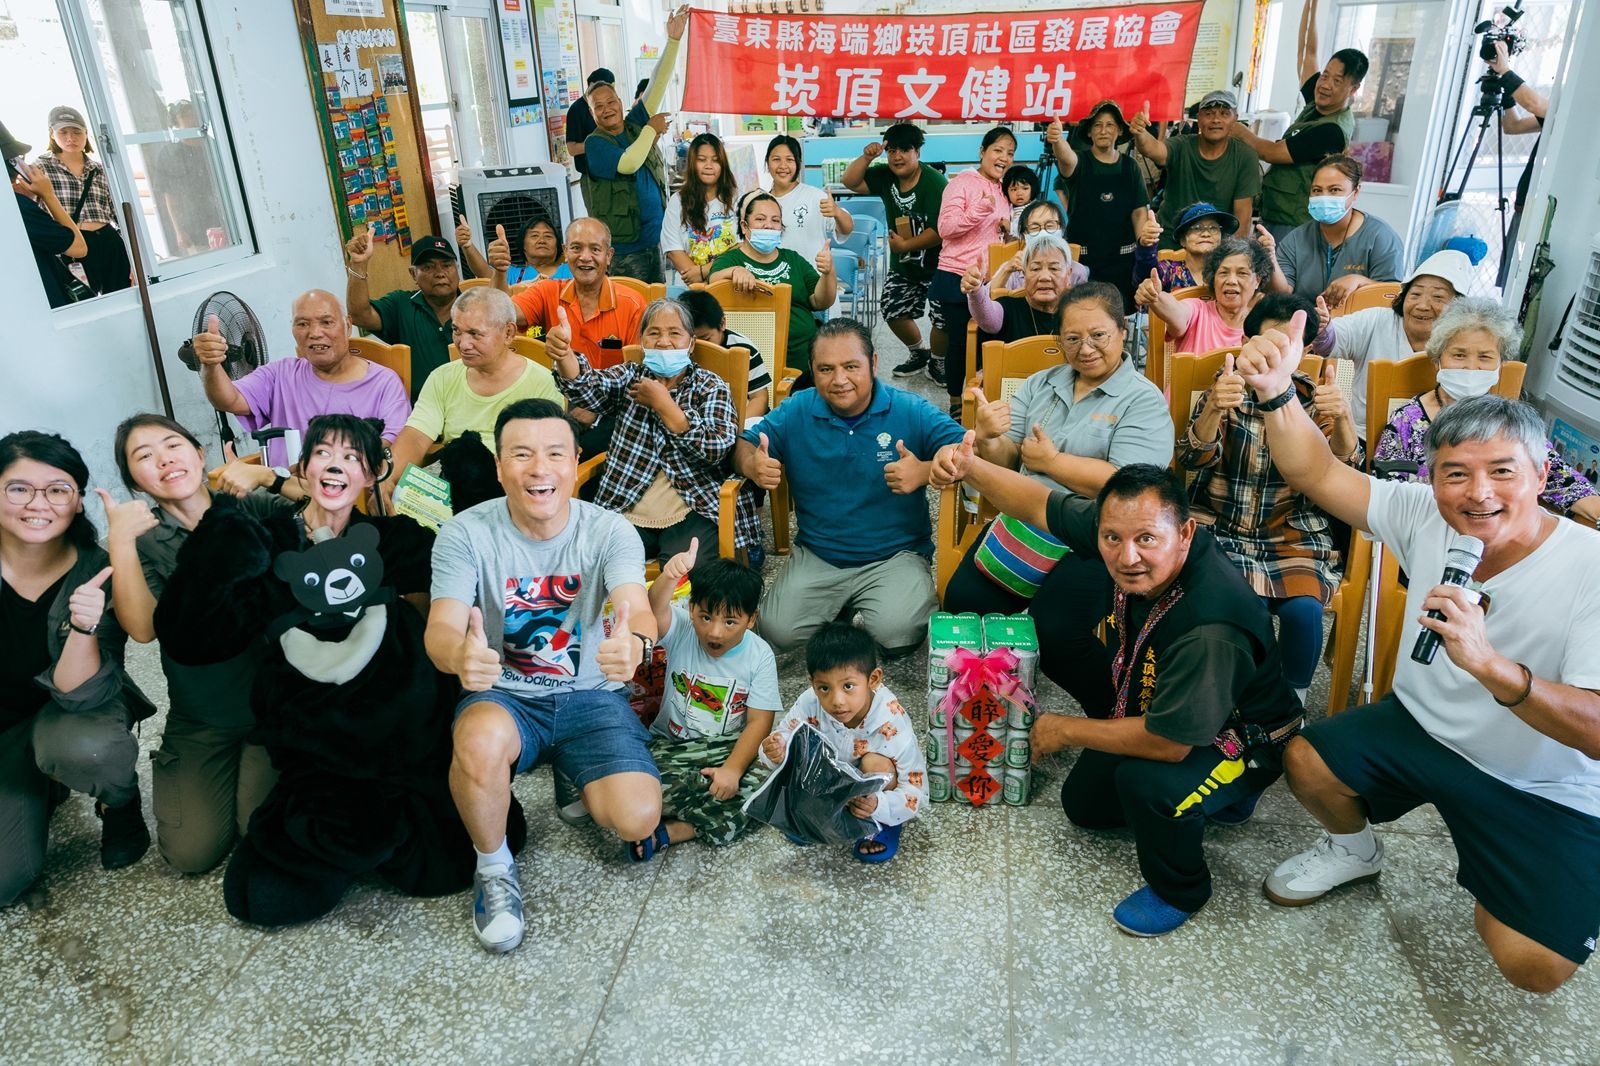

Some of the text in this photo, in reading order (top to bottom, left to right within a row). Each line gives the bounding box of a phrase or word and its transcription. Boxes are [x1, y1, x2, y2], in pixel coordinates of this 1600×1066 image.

[713, 10, 1184, 56] 臺東縣海端鄉崁頂社區發展協會
[770, 62, 1077, 119] 崁頂文健站
[500, 667, 522, 682] new
